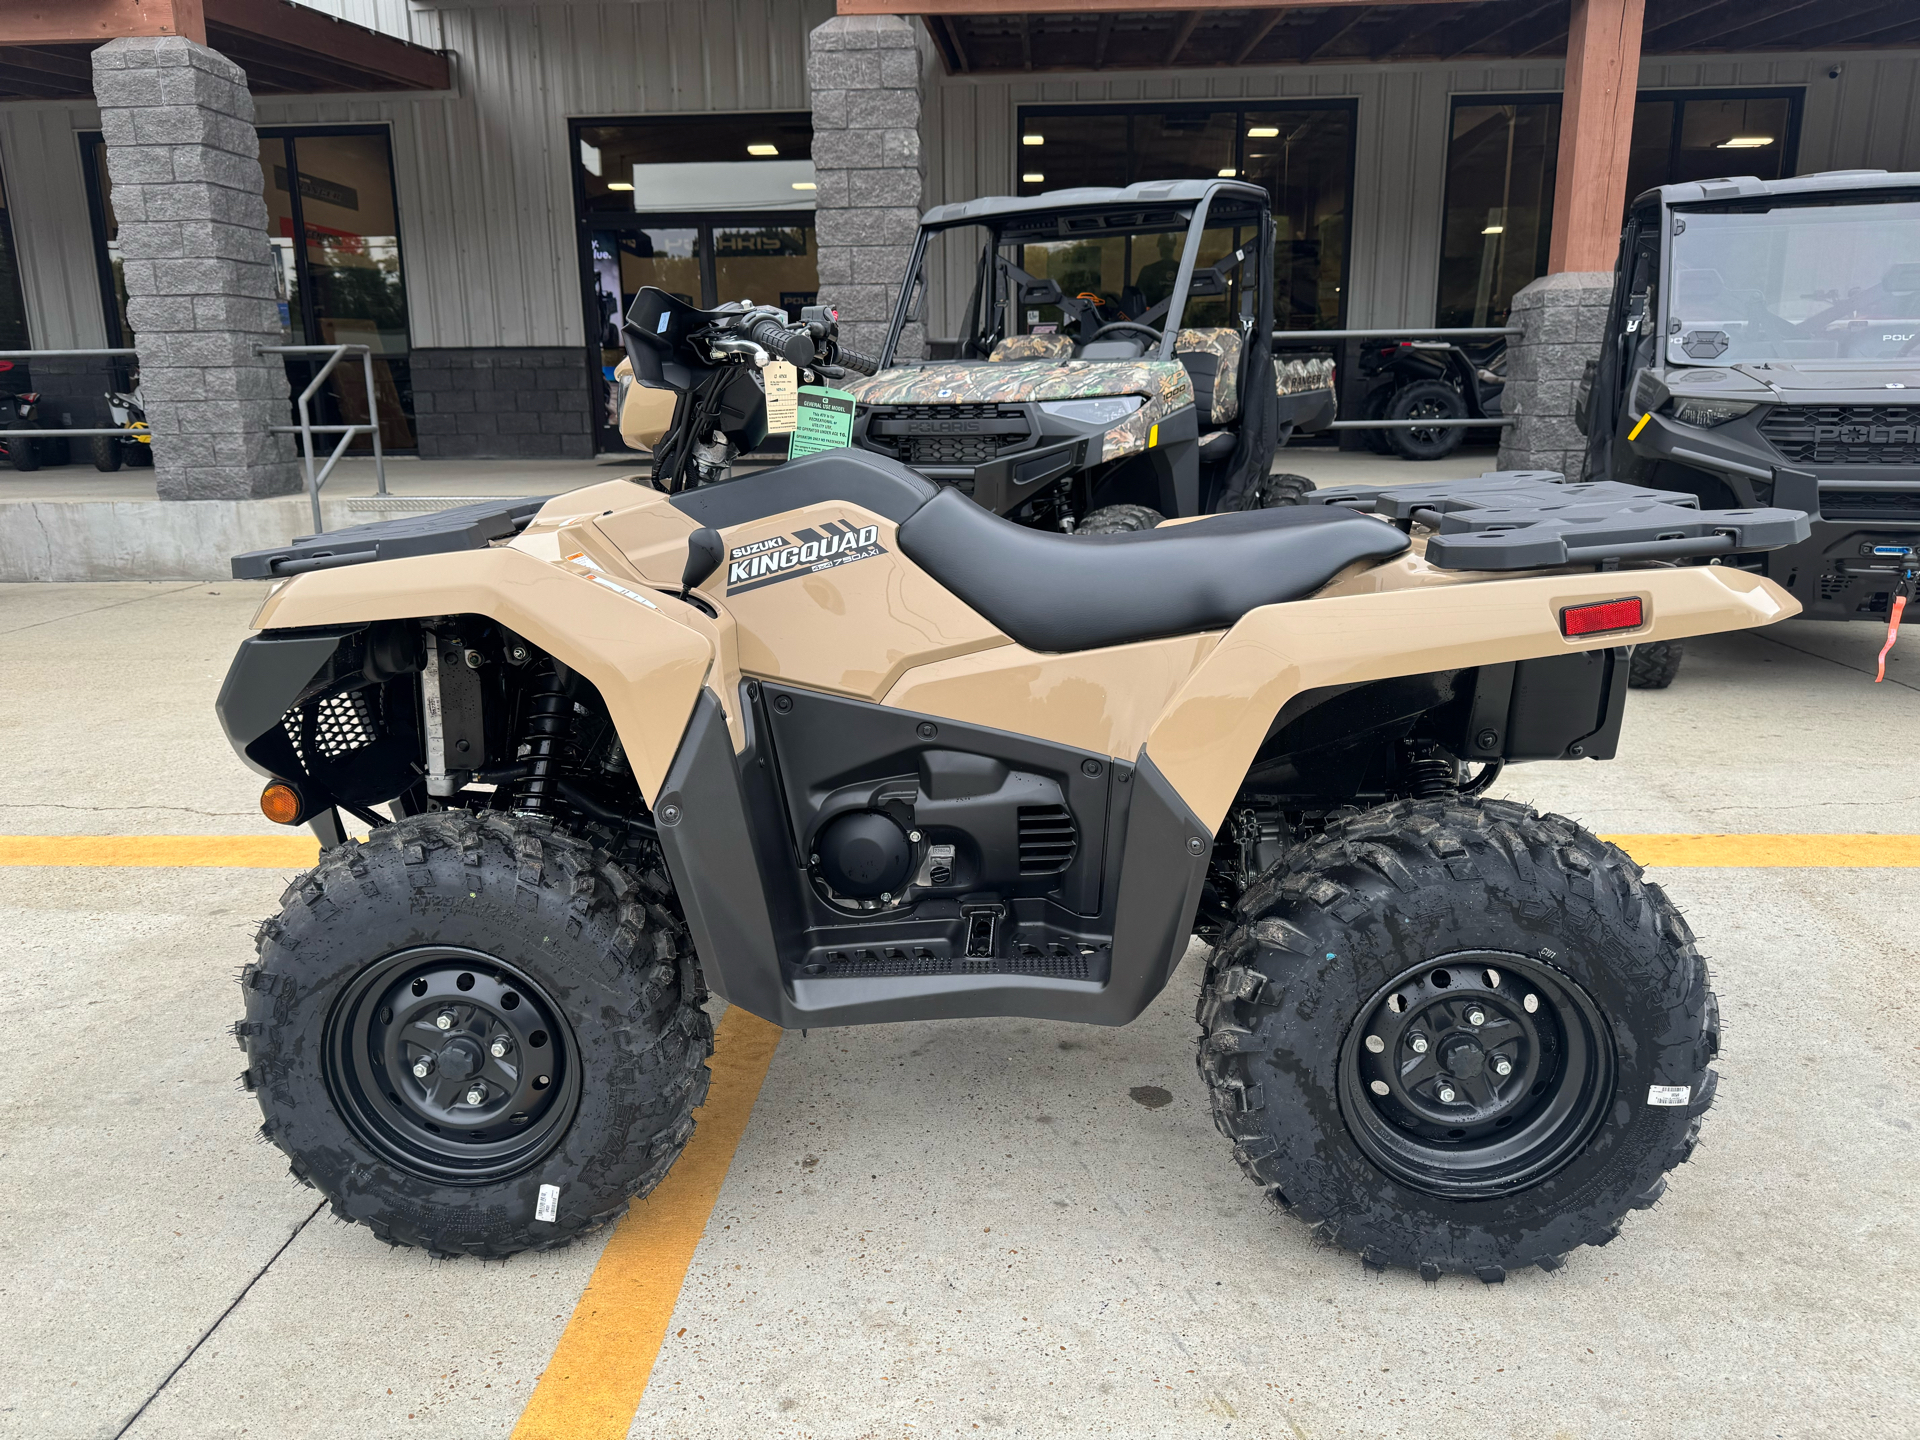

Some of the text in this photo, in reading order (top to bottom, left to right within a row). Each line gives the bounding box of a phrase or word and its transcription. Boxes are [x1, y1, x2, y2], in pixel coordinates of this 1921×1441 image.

[1158, 369, 1186, 393] XP
[1291, 374, 1322, 387] RANGER
[1163, 384, 1186, 400] 1000
[908, 421, 980, 433] POLARIS
[1814, 425, 1919, 443] POLA
[730, 525, 879, 583] KINGQUAD
[732, 537, 783, 558] SUZUKI
